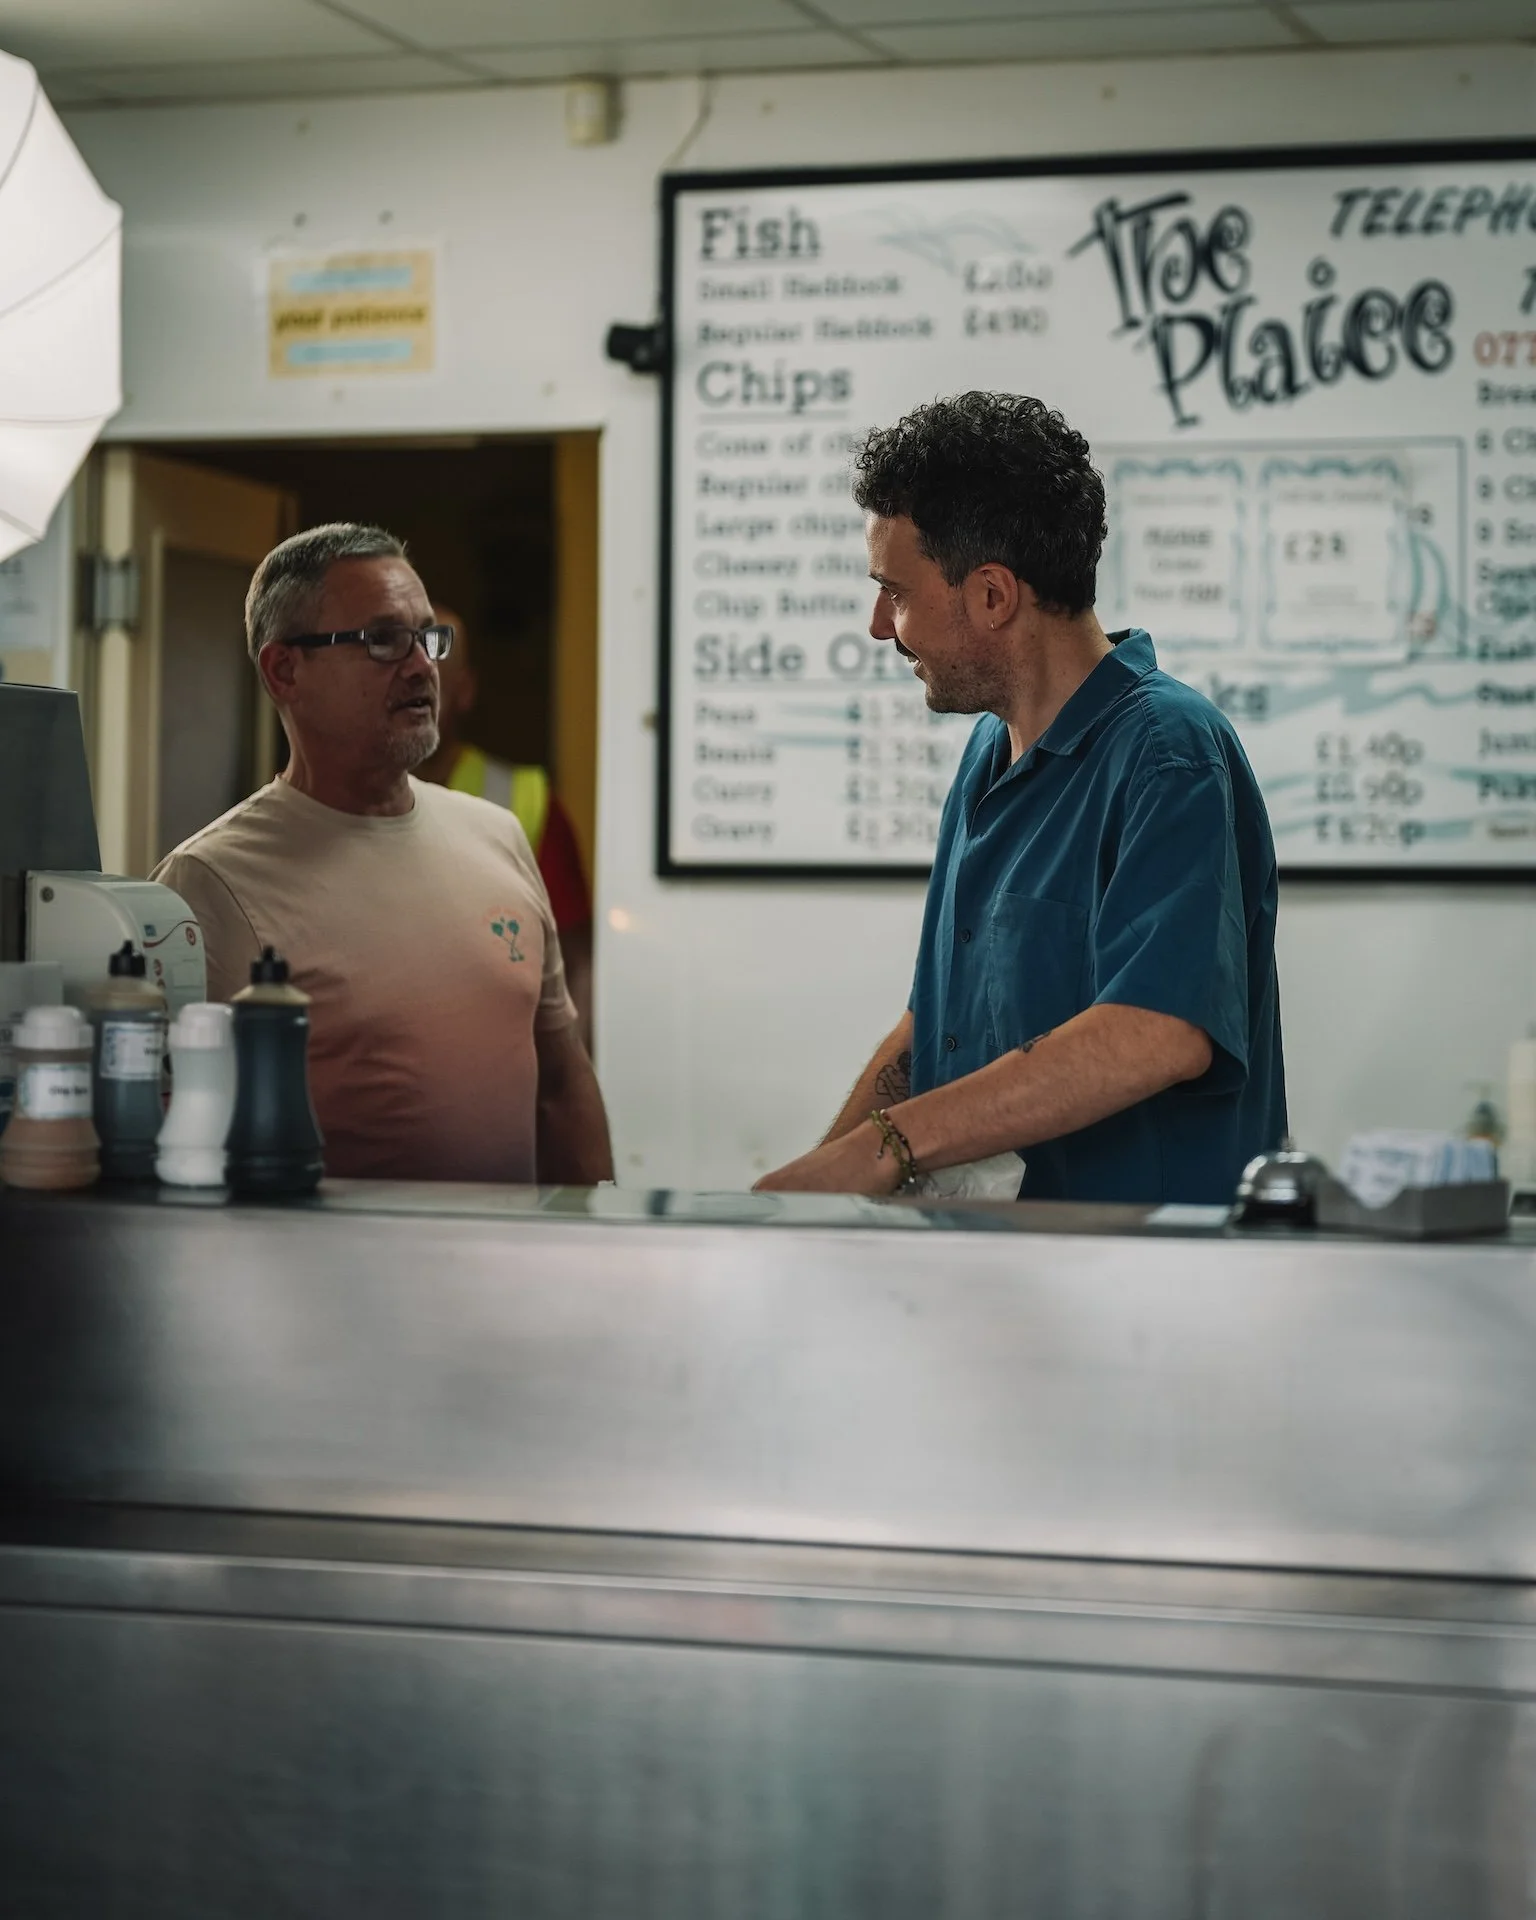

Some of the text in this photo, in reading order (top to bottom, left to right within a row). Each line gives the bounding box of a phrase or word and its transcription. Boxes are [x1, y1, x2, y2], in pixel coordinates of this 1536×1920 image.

[699, 207, 821, 260] Fish
[1067, 192, 1252, 337] The
[697, 276, 772, 301] Small
[782, 272, 903, 297] Haddock
[330, 304, 427, 331] patience
[696, 321, 802, 347] Regular
[814, 315, 937, 341] Haddock
[1138, 257, 1456, 428] Plaice
[696, 359, 853, 414] Chips
[697, 473, 808, 502] Regular
[696, 510, 777, 541] Large
[694, 590, 762, 619] Chip
[694, 633, 807, 678] Side
[695, 737, 777, 765] Beans
